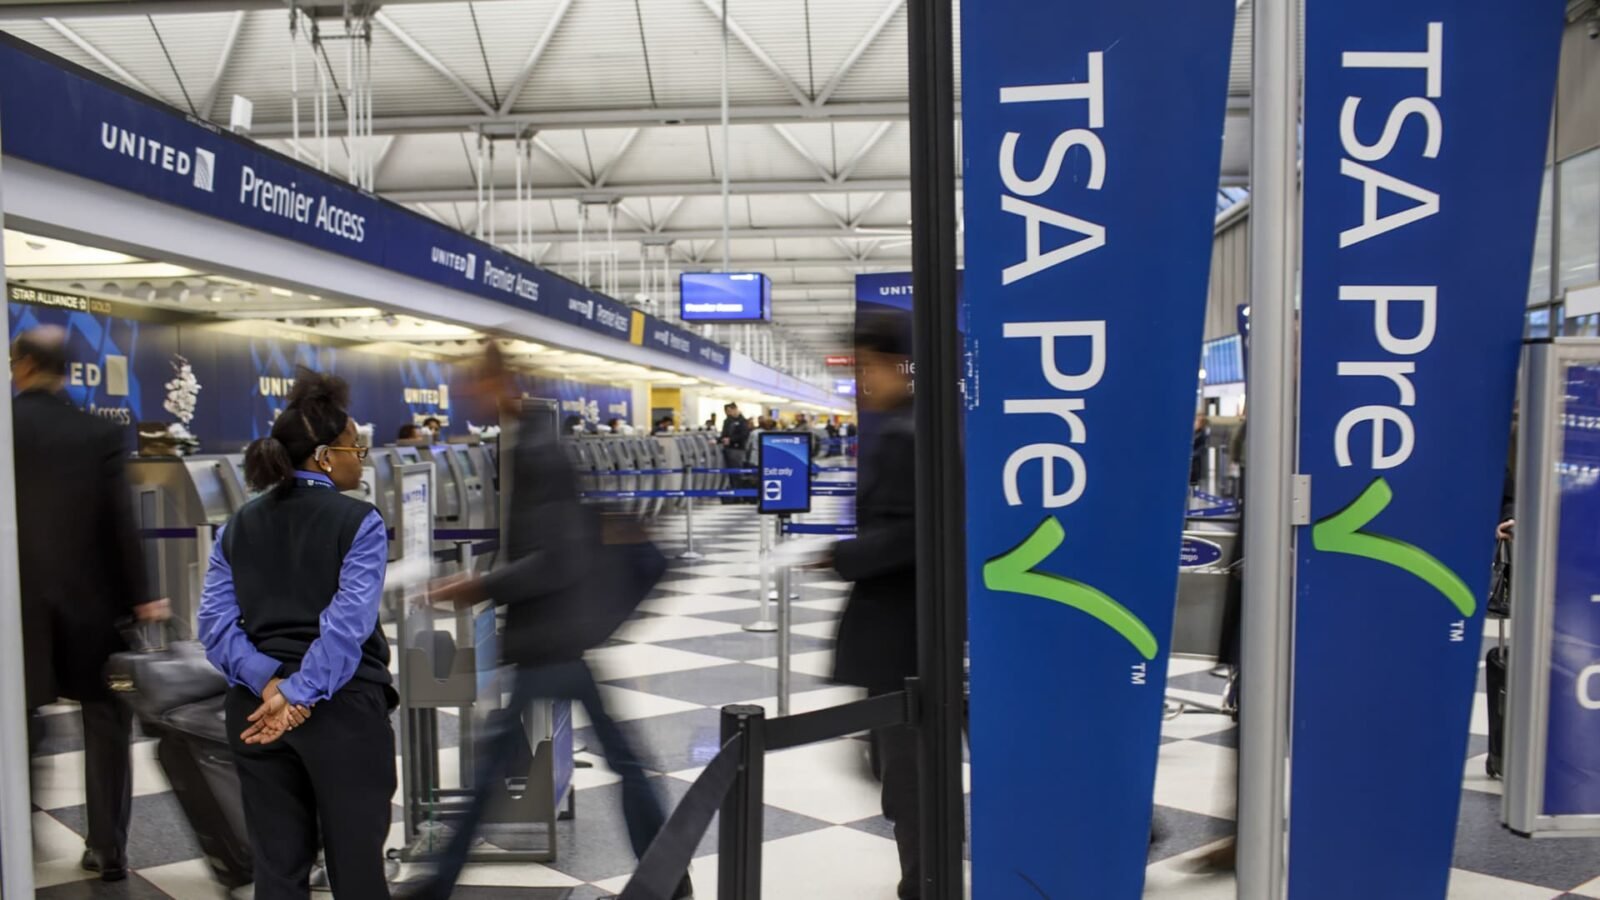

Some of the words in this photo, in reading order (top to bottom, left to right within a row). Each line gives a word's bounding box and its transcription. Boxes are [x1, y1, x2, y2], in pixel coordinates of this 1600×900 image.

[101, 121, 191, 175] UNITED
[240, 165, 314, 224] Premier
[315, 195, 366, 243] Access
[999, 51, 1106, 286] TSA
[1340, 21, 1443, 248] TSA
[12, 287, 36, 302] STAR
[37, 291, 78, 309] ALLIANCE
[431, 246, 467, 272] UNITED
[483, 259, 516, 292] Premier
[515, 273, 539, 301] Access
[1002, 320, 1106, 508] Pre
[1334, 285, 1437, 469] Pre
[1131, 662, 1146, 685] TM
